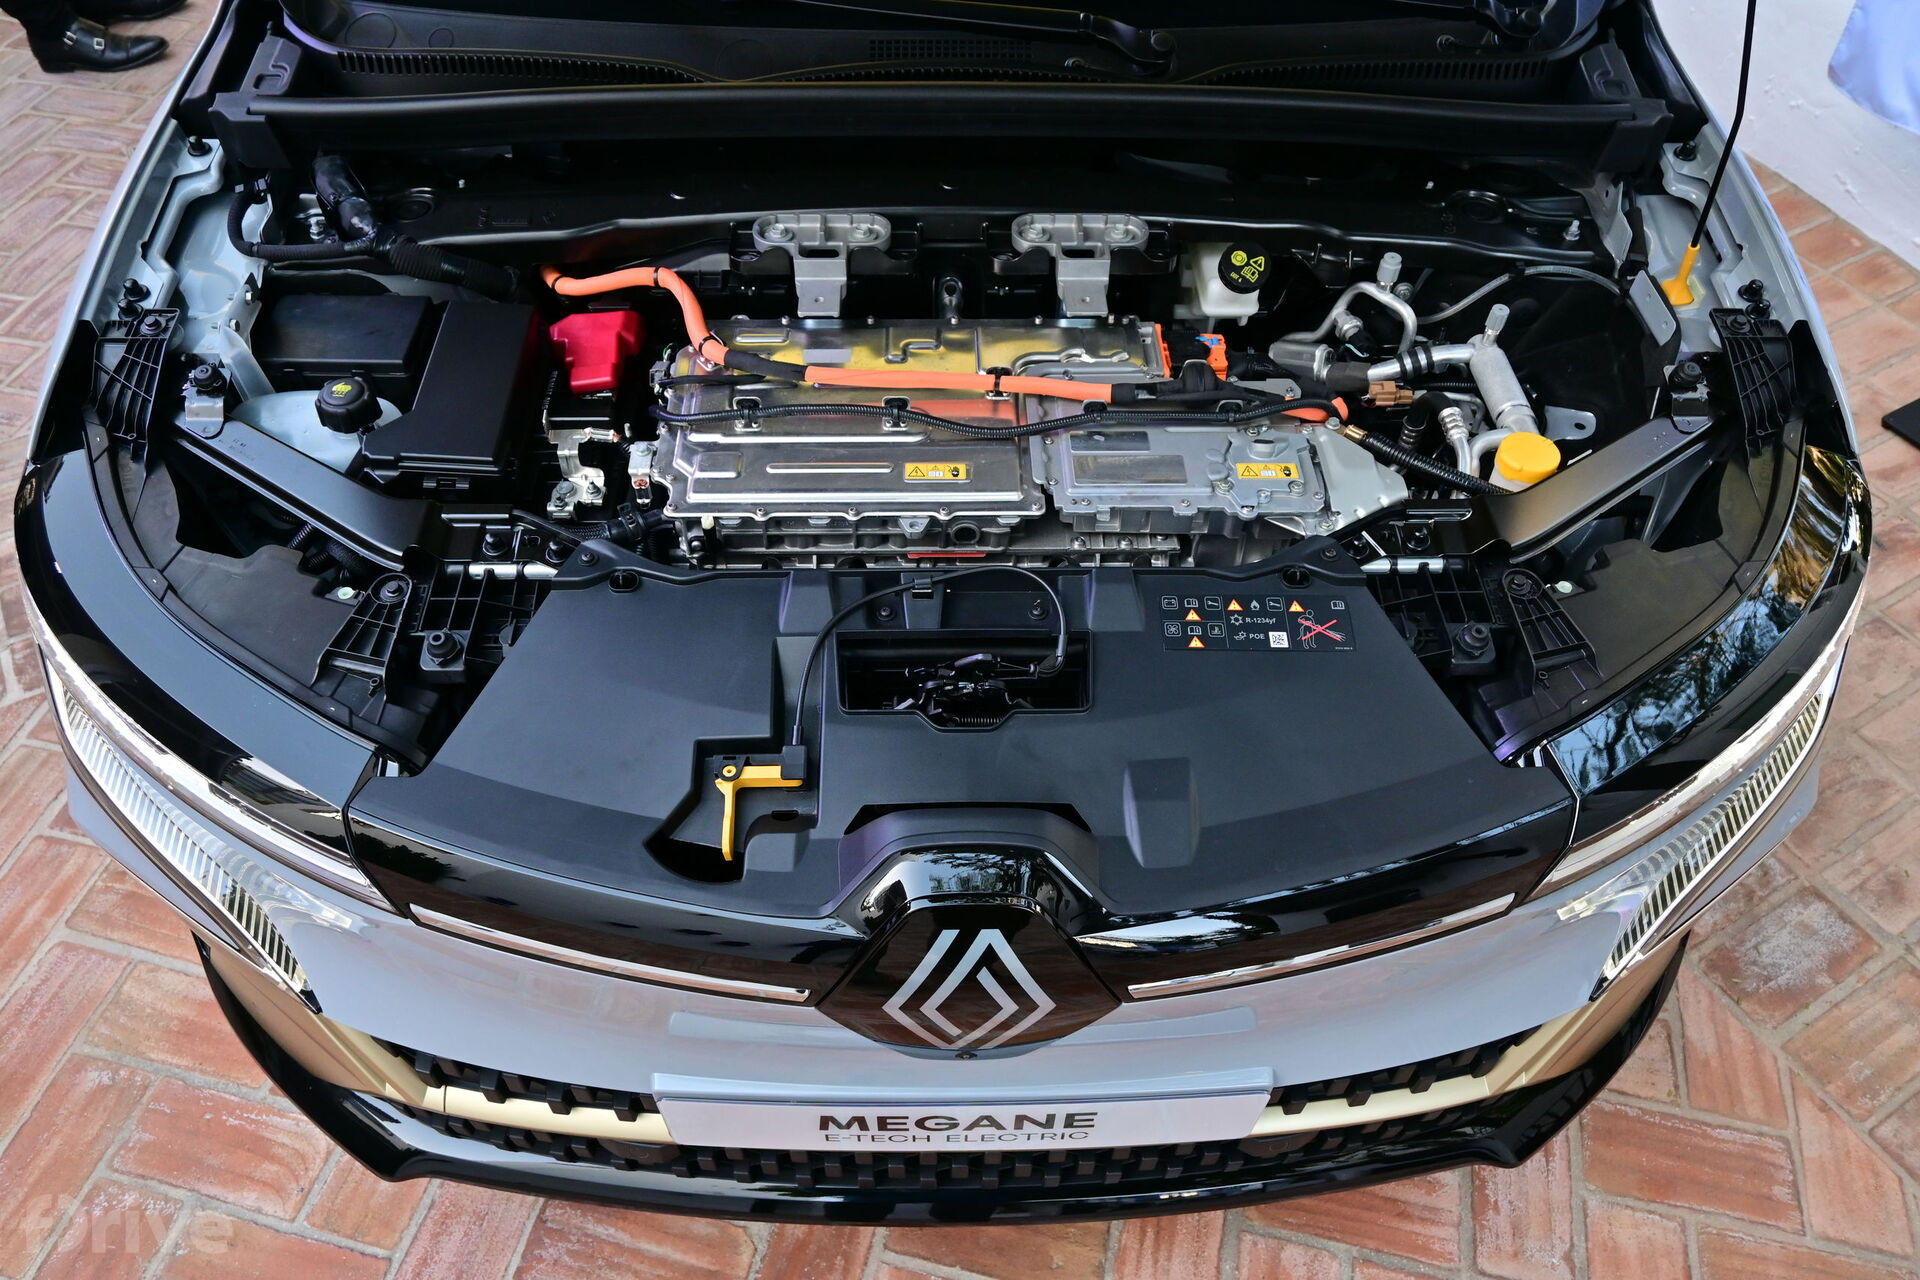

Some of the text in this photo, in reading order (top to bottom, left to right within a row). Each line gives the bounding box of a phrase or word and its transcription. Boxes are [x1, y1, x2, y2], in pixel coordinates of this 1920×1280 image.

[1245, 617, 1276, 625] R-1234yf
[819, 1112, 1098, 1132] MEGANE
[825, 1131, 1089, 1143] E-TECH ELECTRIC
